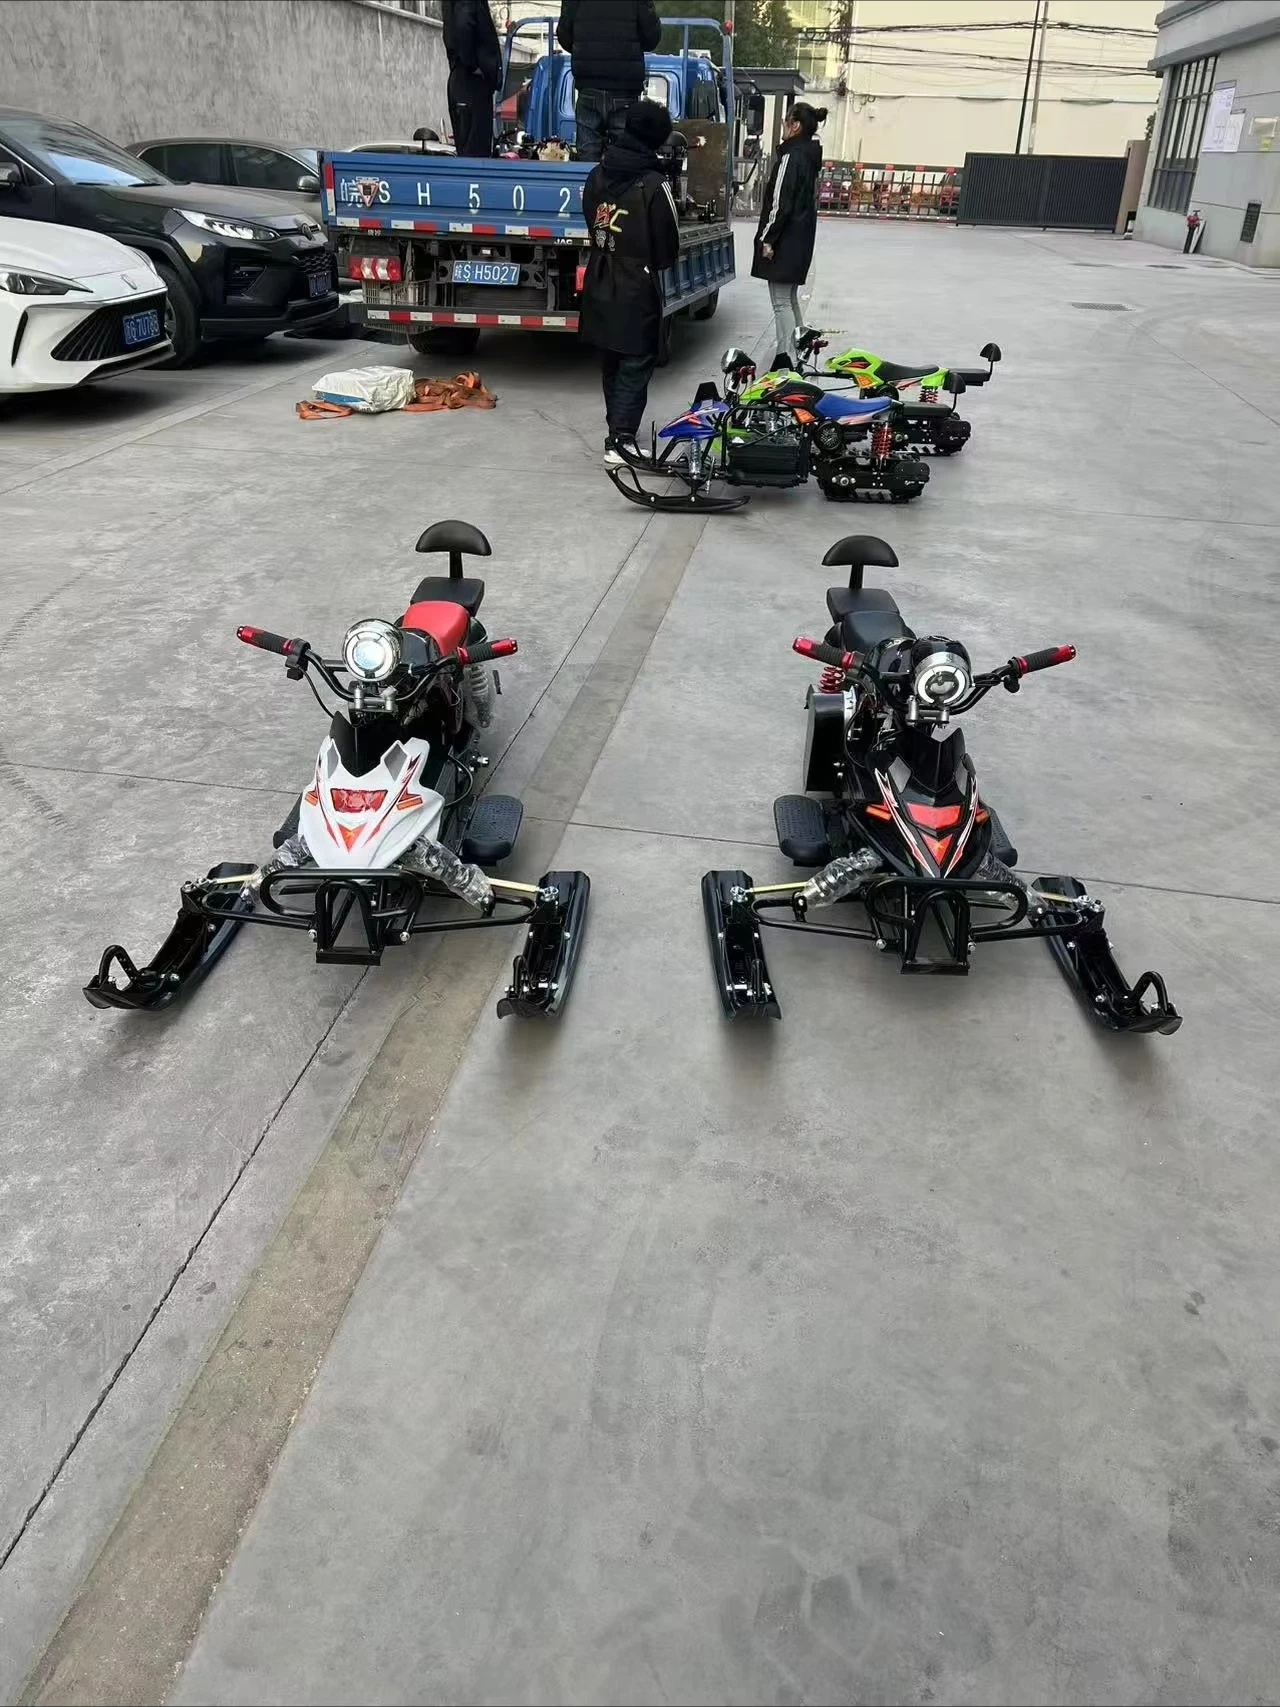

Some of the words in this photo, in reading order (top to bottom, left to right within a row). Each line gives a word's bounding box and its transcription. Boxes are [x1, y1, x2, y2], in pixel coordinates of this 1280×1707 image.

[378, 180, 391, 203] S
[417, 182, 431, 206] H
[469, 183, 481, 214] 5
[559, 187, 571, 217] 2
